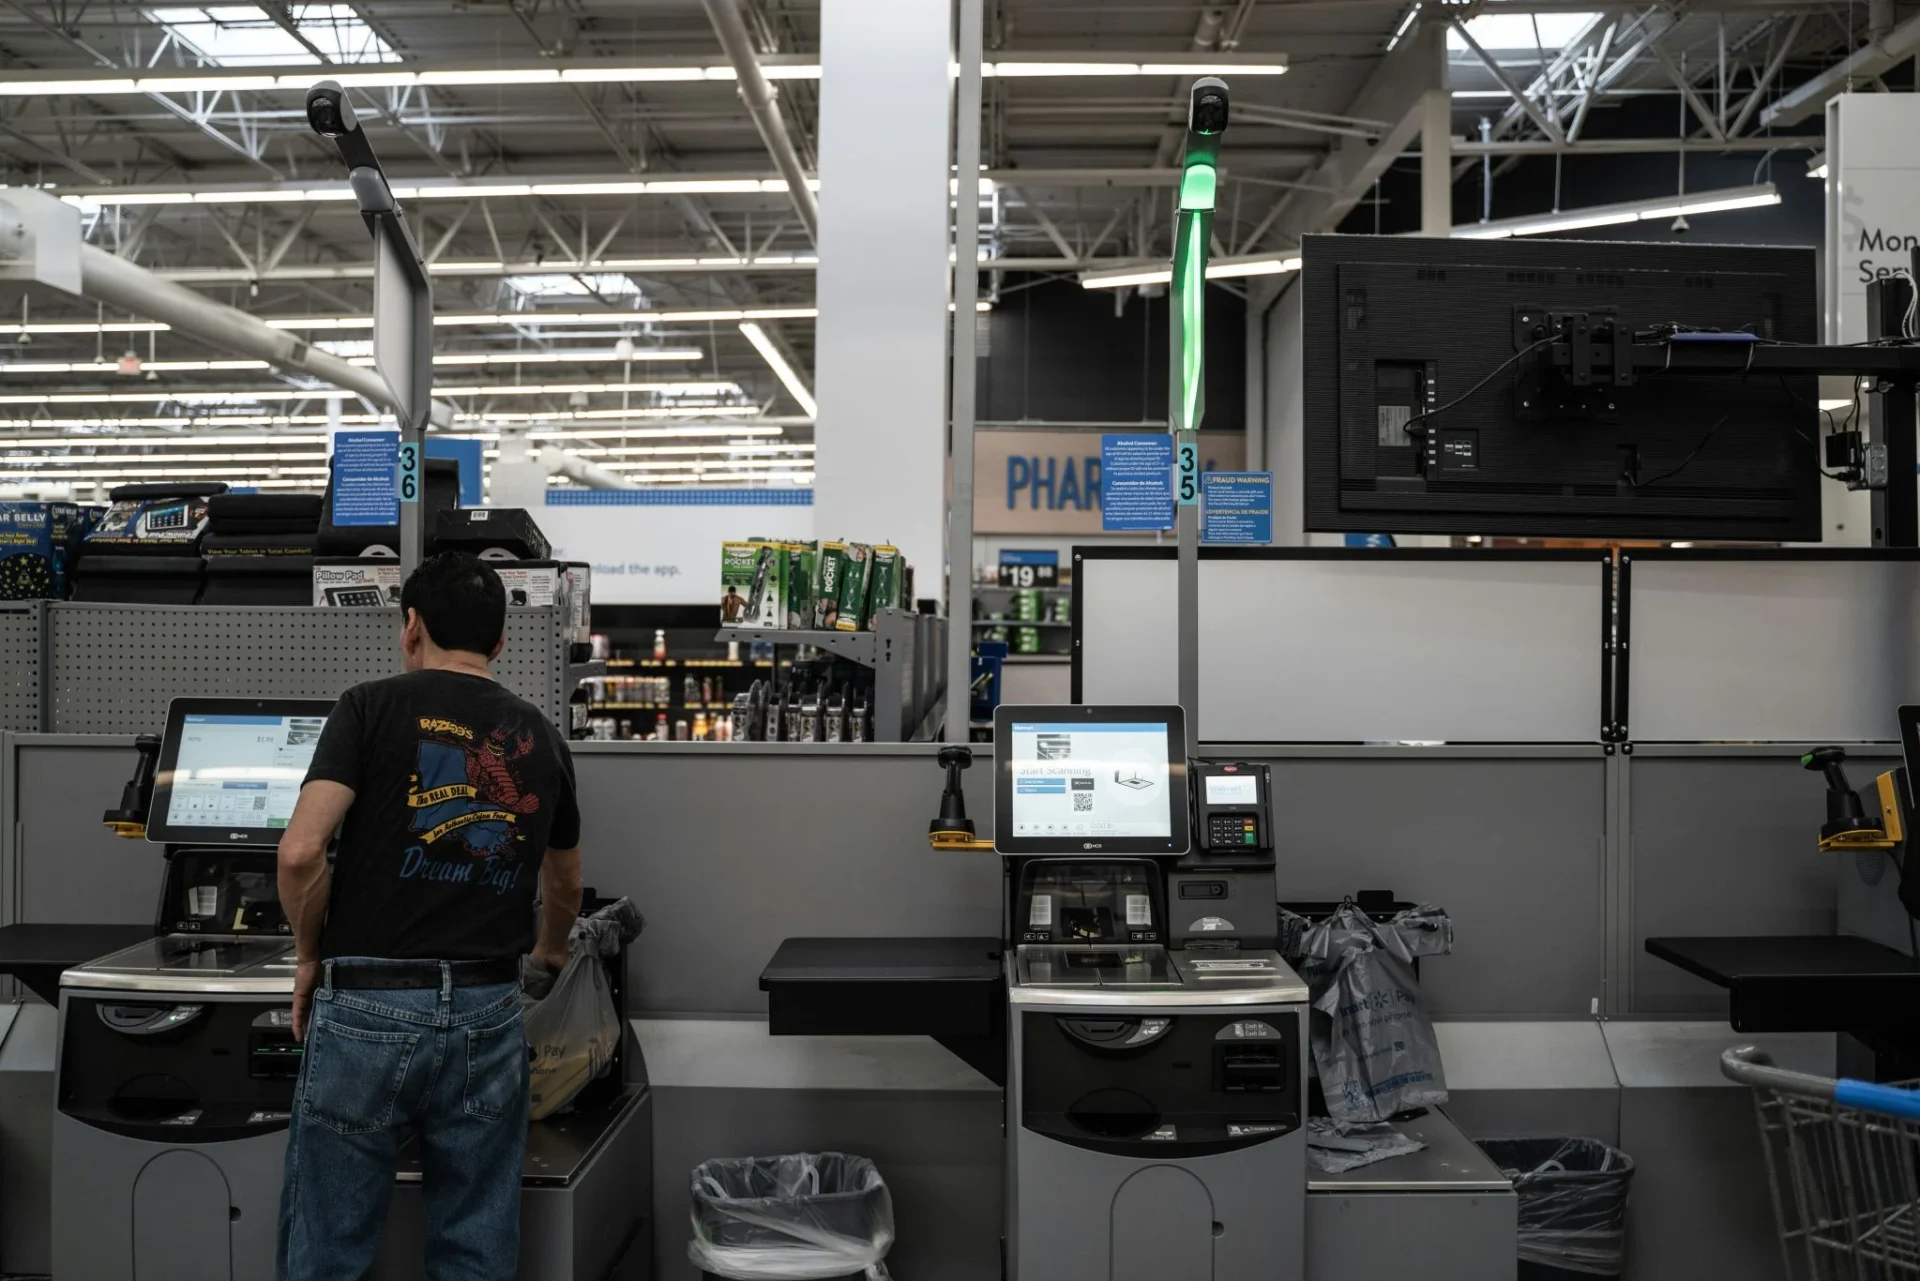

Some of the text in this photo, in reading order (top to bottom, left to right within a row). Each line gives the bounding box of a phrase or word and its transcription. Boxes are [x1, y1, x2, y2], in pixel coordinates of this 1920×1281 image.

[14, 513, 46, 522] BELLY
[724, 558, 756, 566] ROCKET
[316, 570, 344, 581] Pillow
[345, 570, 365, 580] Pad
[824, 556, 836, 592] ROCKET
[416, 786, 468, 806] The REAL DEAL
[492, 812, 508, 820] Food
[400, 846, 524, 895] Dream Big!
[1384, 1011, 1413, 1023] phone
[544, 1044, 567, 1060] Pay
